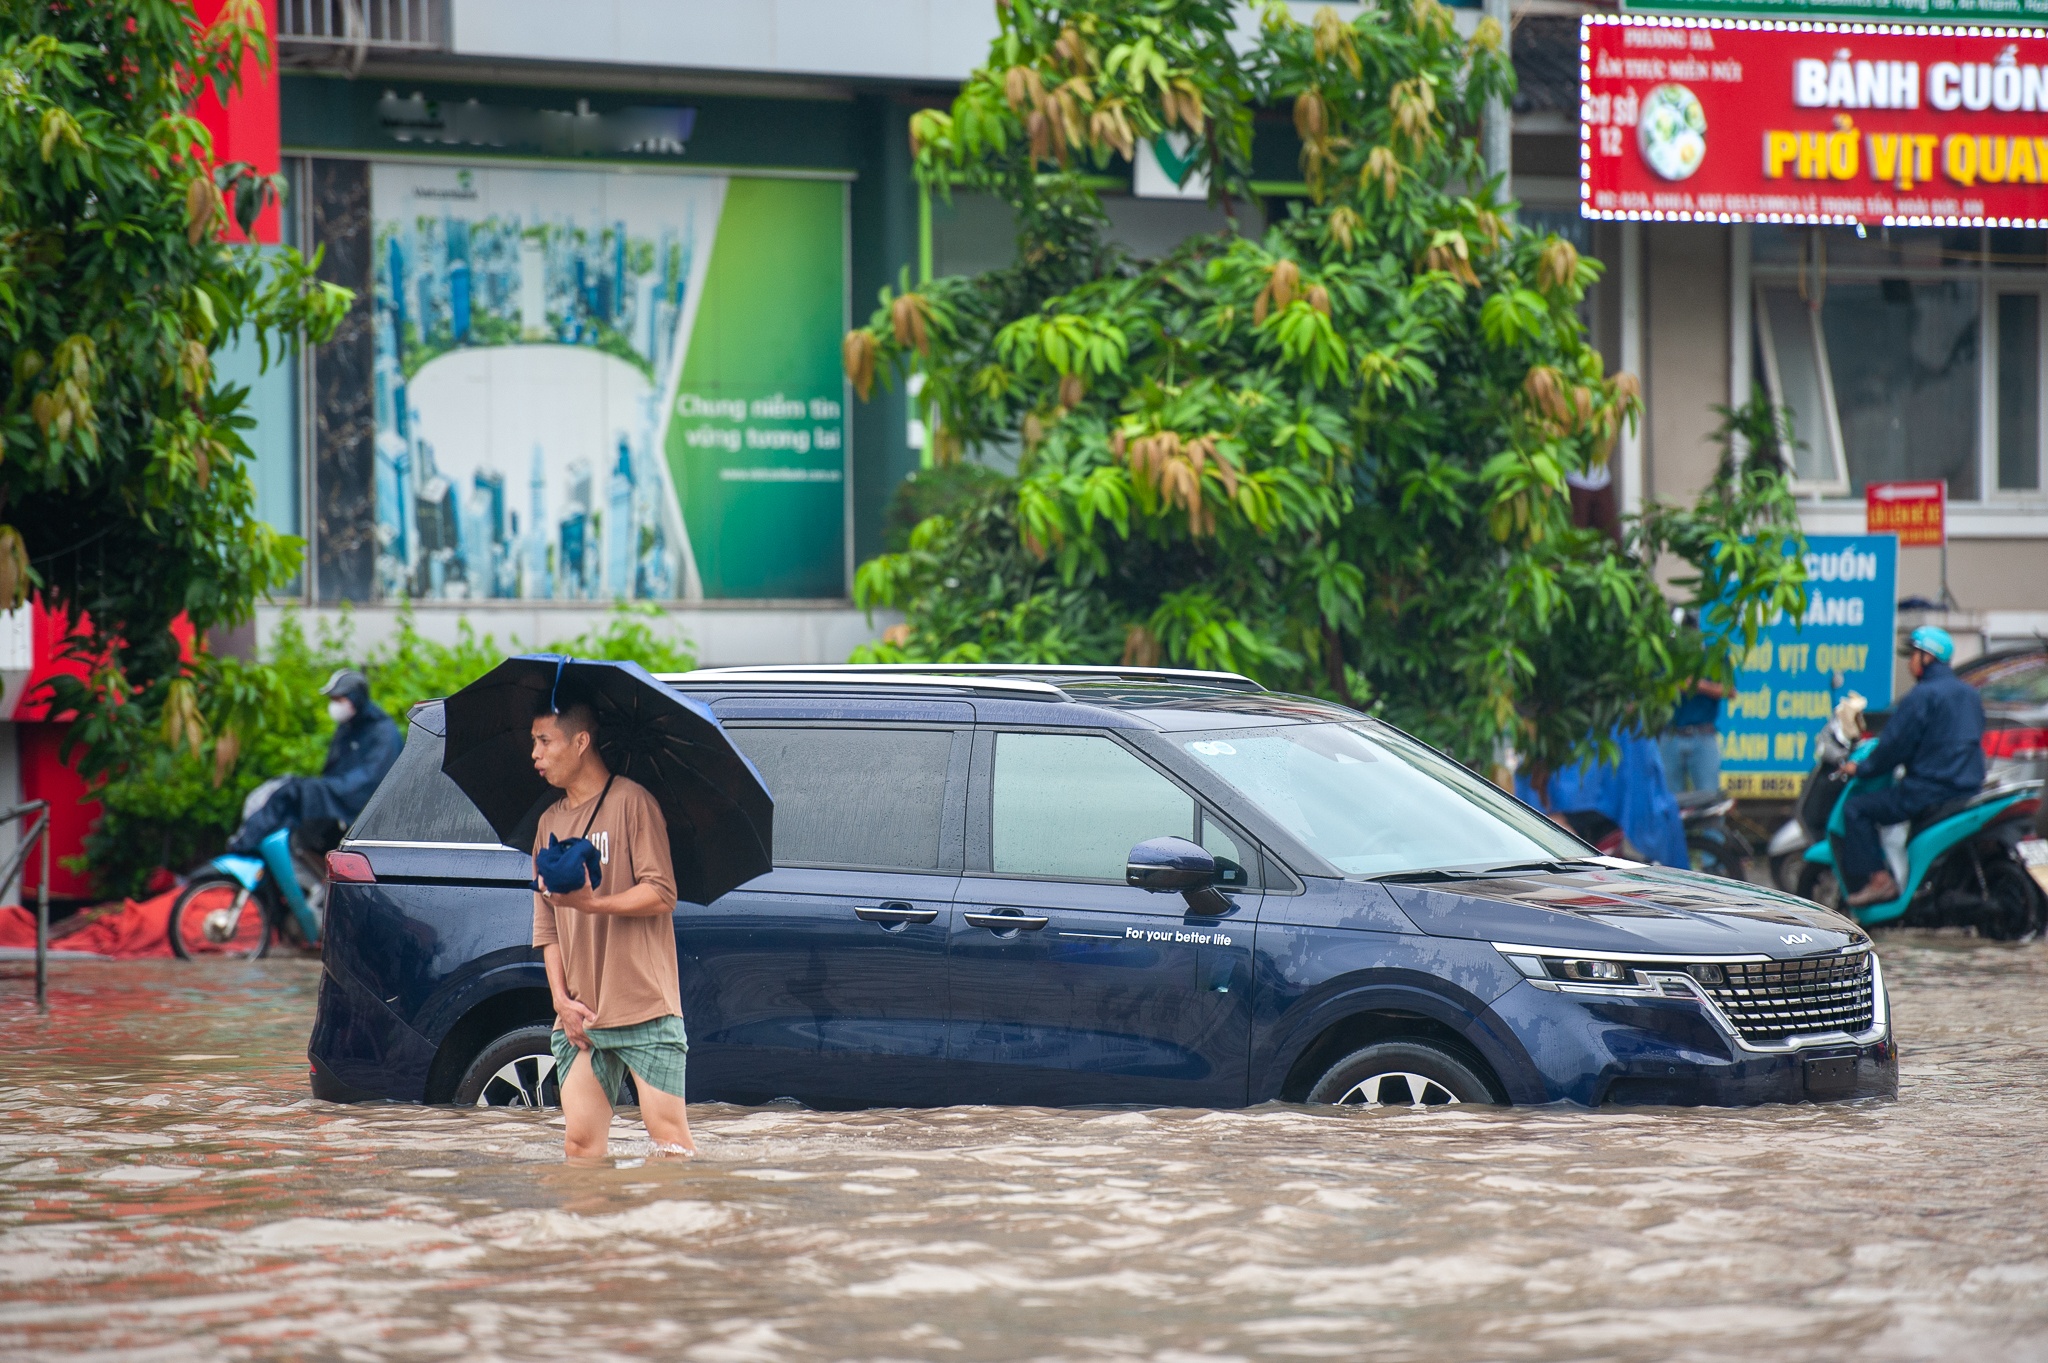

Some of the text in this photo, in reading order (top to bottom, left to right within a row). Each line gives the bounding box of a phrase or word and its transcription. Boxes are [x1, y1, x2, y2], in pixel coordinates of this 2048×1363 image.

[1792, 44, 2048, 112] BÁNH CUỐN
[1599, 126, 1623, 156] 12
[1763, 113, 1861, 180] PHỞ
[1866, 133, 1938, 190] VỊT
[677, 393, 747, 423] Chung
[809, 396, 841, 420] tin
[813, 426, 841, 450] lai
[1802, 544, 1877, 582] CUỐN
[1777, 643, 1810, 679] VỊT
[1814, 643, 1869, 675] QUAY
[1727, 684, 1771, 719] PHỞ
[1126, 927, 1232, 946] For your better life
